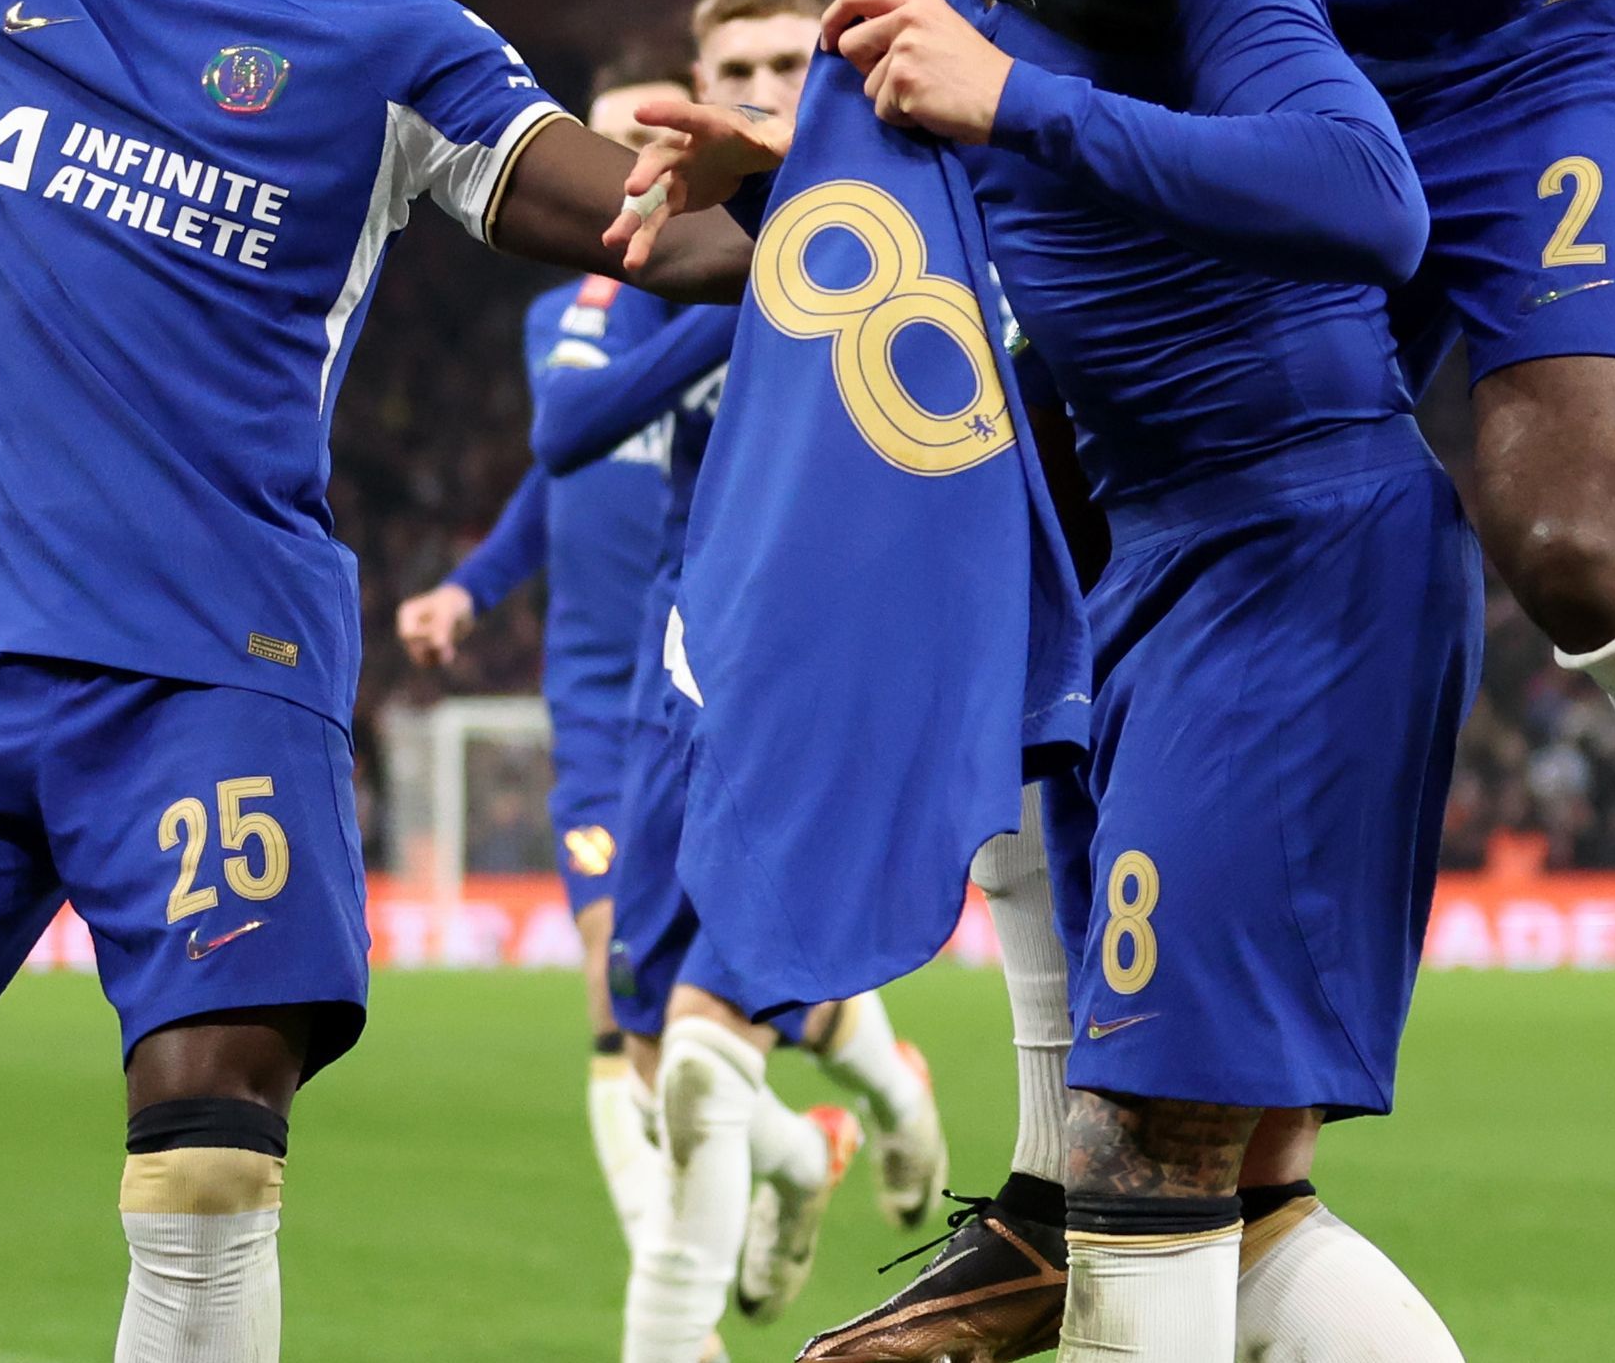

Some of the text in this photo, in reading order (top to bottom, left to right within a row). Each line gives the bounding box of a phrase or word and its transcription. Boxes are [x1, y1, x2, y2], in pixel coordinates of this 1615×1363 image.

[43, 165, 276, 269] ATHLETE
[61, 122, 289, 225] INFINITE
[1538, 155, 1606, 268] 2
[751, 179, 1017, 477] 8
[158, 776, 289, 924] 25
[1102, 850, 1159, 994] 8
